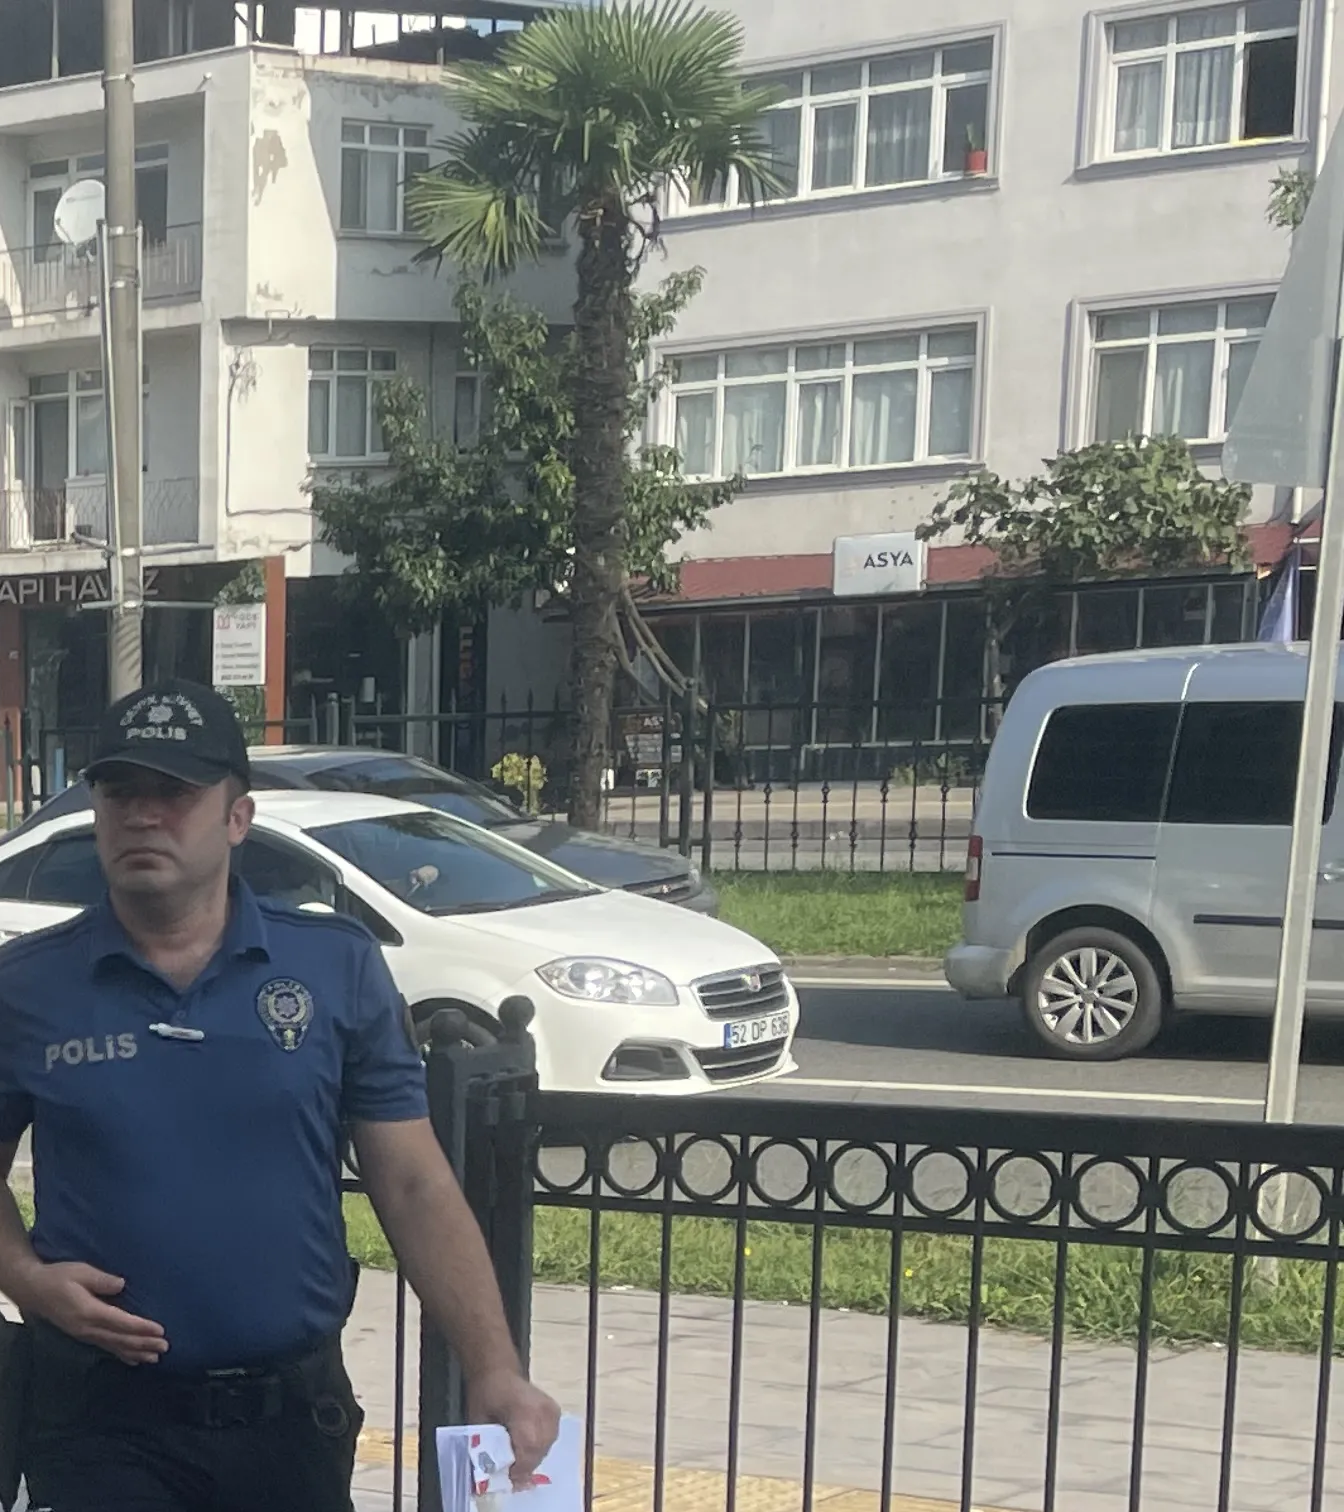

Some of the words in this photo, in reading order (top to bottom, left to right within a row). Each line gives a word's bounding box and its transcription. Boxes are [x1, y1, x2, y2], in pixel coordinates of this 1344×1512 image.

[863, 551, 914, 571] ASYA
[732, 1024, 747, 1045] 52
[752, 1020, 767, 1041] DP
